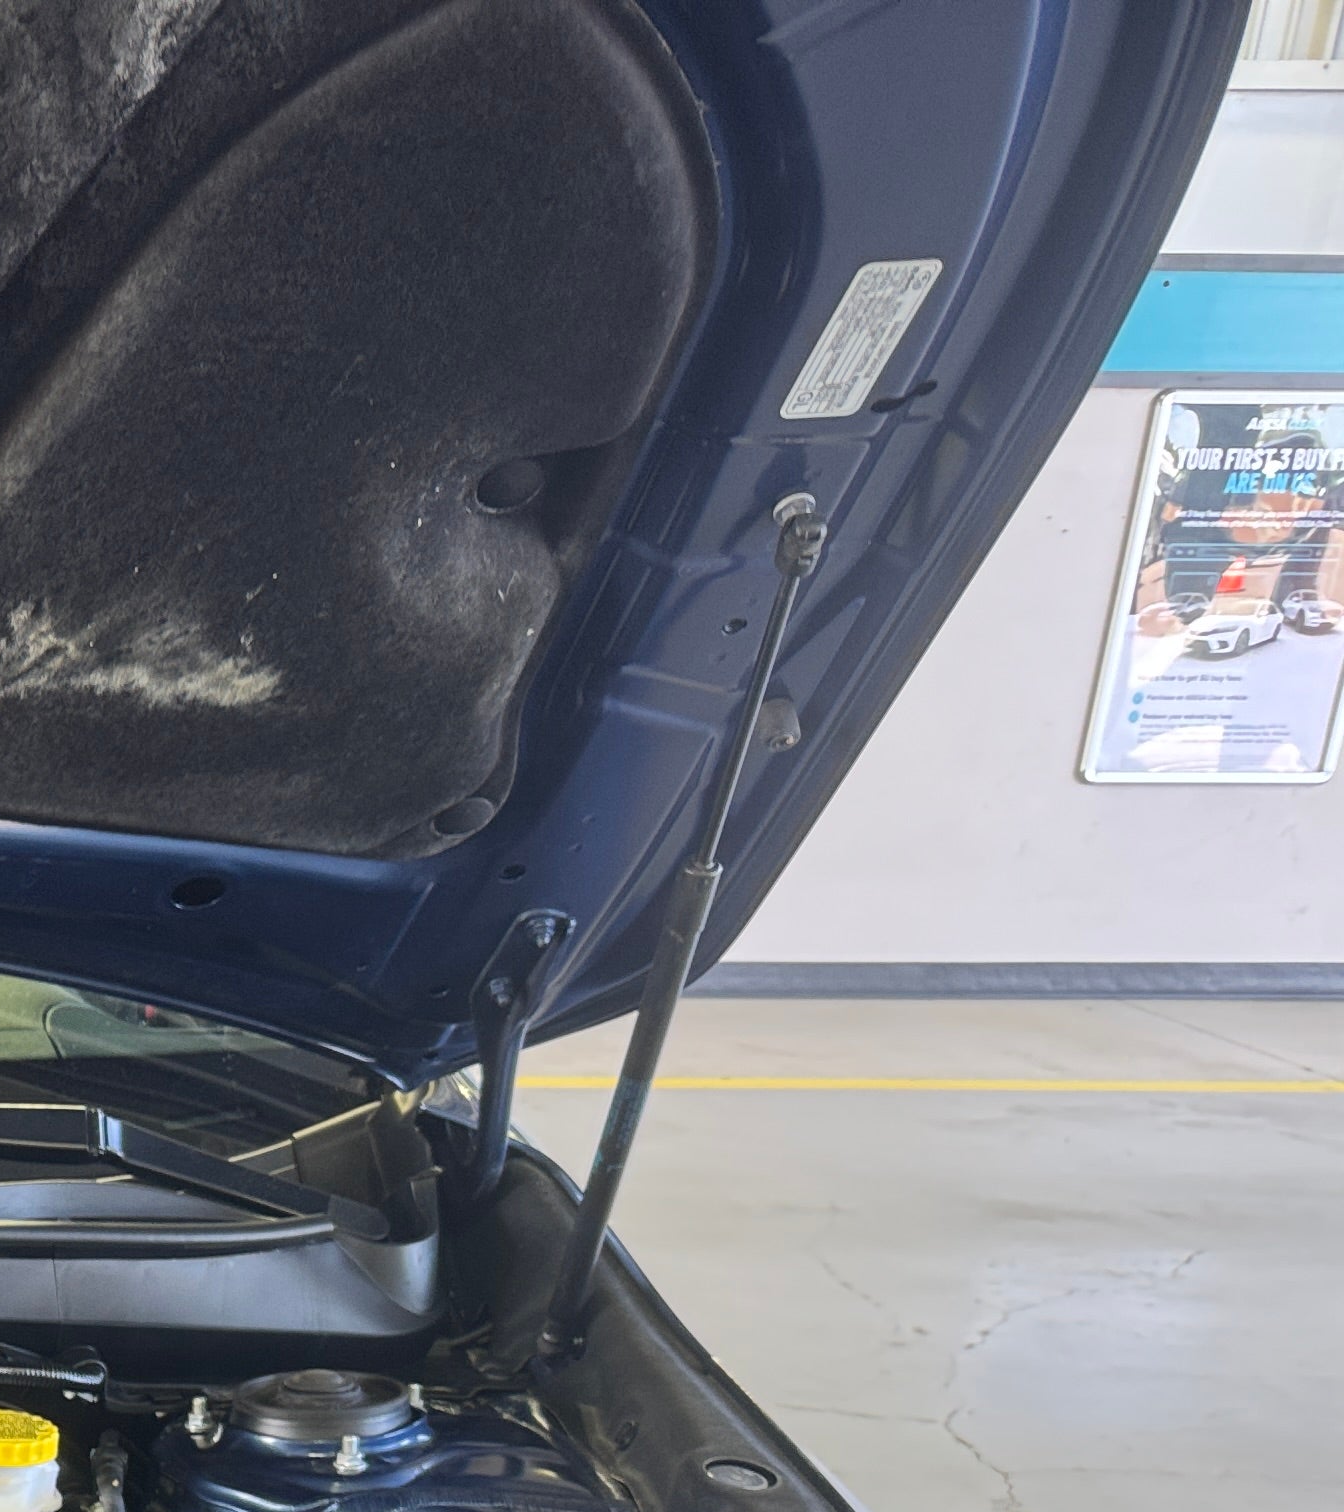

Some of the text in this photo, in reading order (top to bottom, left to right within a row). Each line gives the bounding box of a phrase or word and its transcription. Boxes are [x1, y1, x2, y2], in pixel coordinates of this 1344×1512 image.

[1177, 448, 1223, 470] YOUR
[1223, 448, 1273, 470] FIRST
[1278, 448, 1292, 470] 3
[1292, 448, 1330, 471] BUY
[1223, 472, 1262, 494] ARE
[1262, 473, 1290, 494] ON
